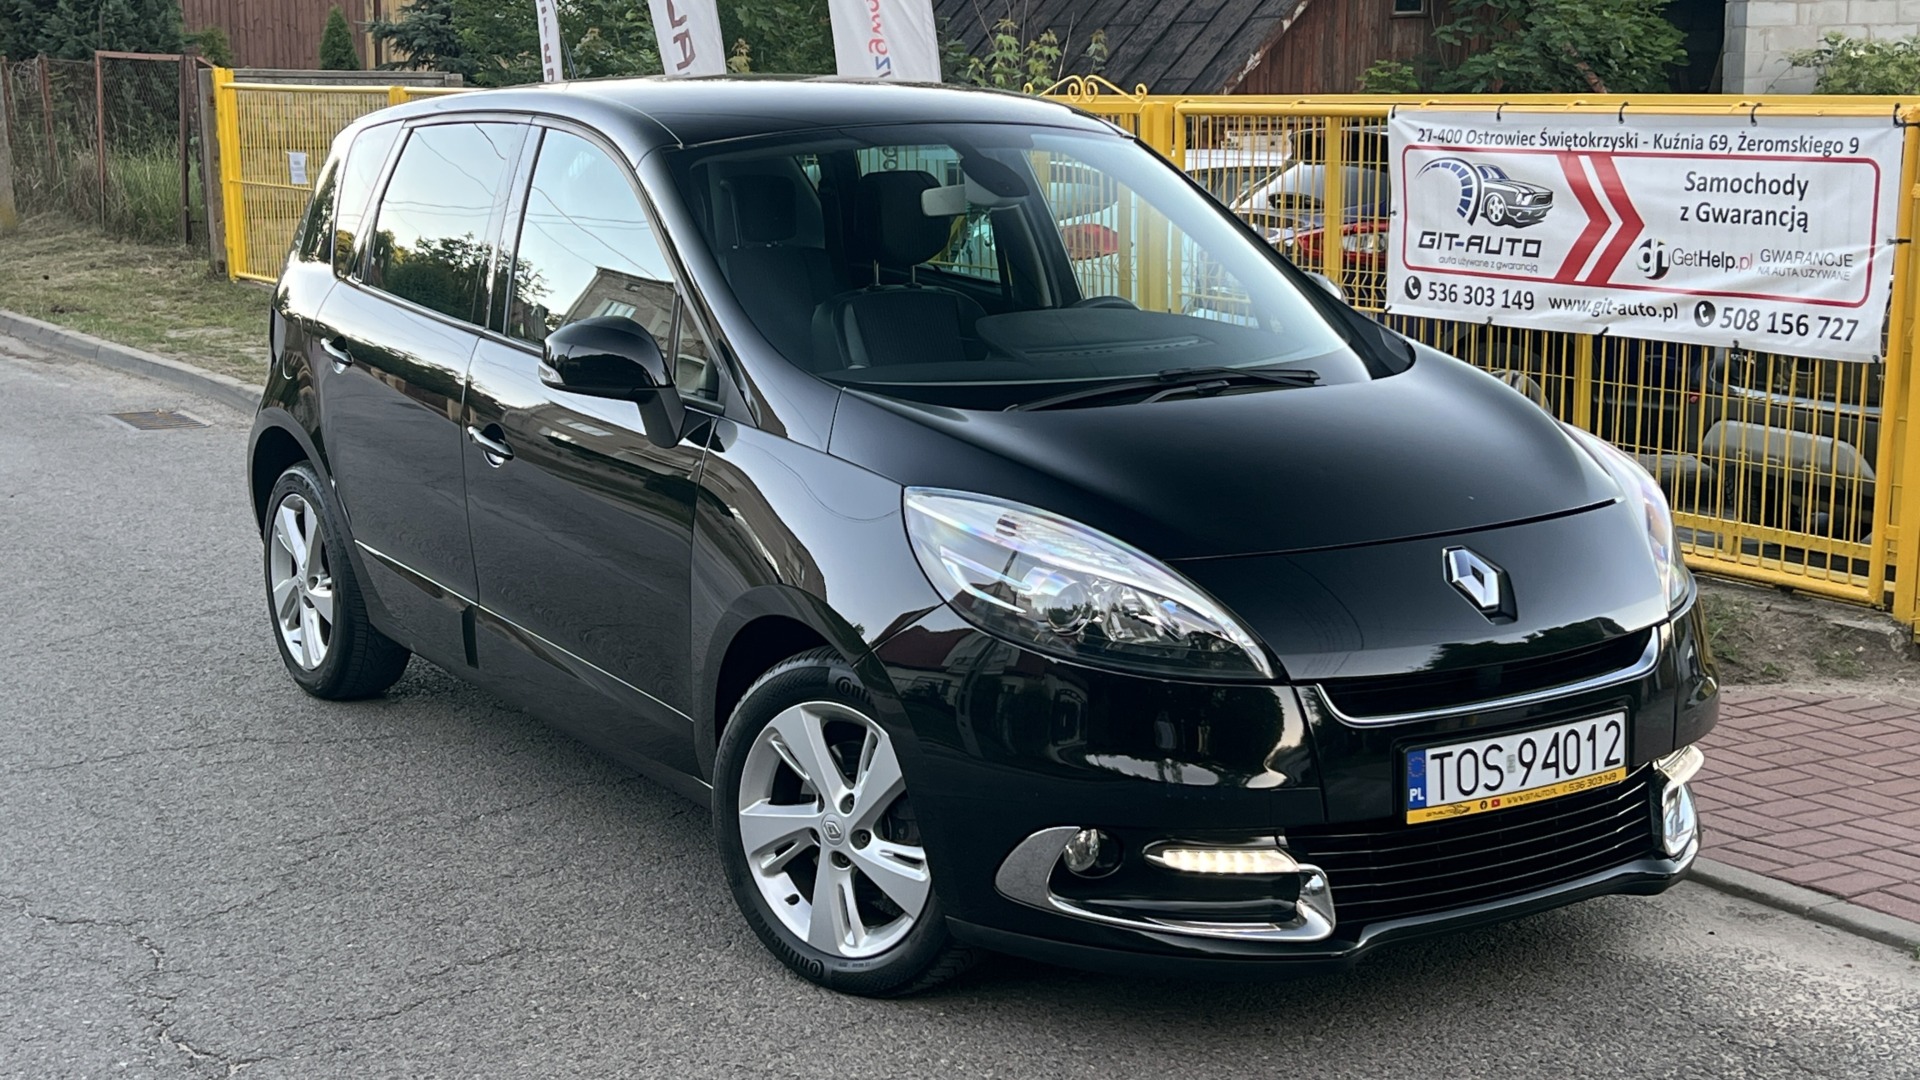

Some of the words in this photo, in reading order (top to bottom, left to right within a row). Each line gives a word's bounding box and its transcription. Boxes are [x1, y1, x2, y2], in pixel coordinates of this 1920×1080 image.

[1417, 127, 1462, 144] 27-400
[1466, 129, 1536, 147] Ostrowiec
[1540, 127, 1639, 152] Świętokrzyski
[1653, 132, 1704, 151] Kuźnia
[1709, 134, 1732, 154] 69,
[1737, 131, 1844, 158] Żeromskiego
[1849, 136, 1860, 154] 9
[1684, 170, 1809, 201] Samochody
[1680, 205, 1689, 222] z
[1696, 201, 1809, 233] Gwarancją
[1417, 231, 1542, 258] GIT-AUTO
[1760, 248, 1854, 268] GWARANCJE
[1439, 256, 1457, 265] auta
[1457, 256, 1489, 268] używane
[1496, 261, 1538, 274] gwarancją
[1671, 247, 1753, 273] GetHelp.pl
[1757, 266, 1771, 275] NA
[1771, 266, 1799, 278] AUTA
[1427, 281, 1458, 304] 536
[1463, 284, 1495, 307] 303
[1501, 288, 1535, 311] 149
[1548, 297, 1679, 321] www.git-auto.pl
[1719, 306, 1760, 332] 508
[1766, 310, 1810, 336] 156
[1817, 315, 1859, 342] 727
[1430, 743, 1504, 801] TOS
[1518, 719, 1621, 787] 94012
[1409, 787, 1425, 802] PL
